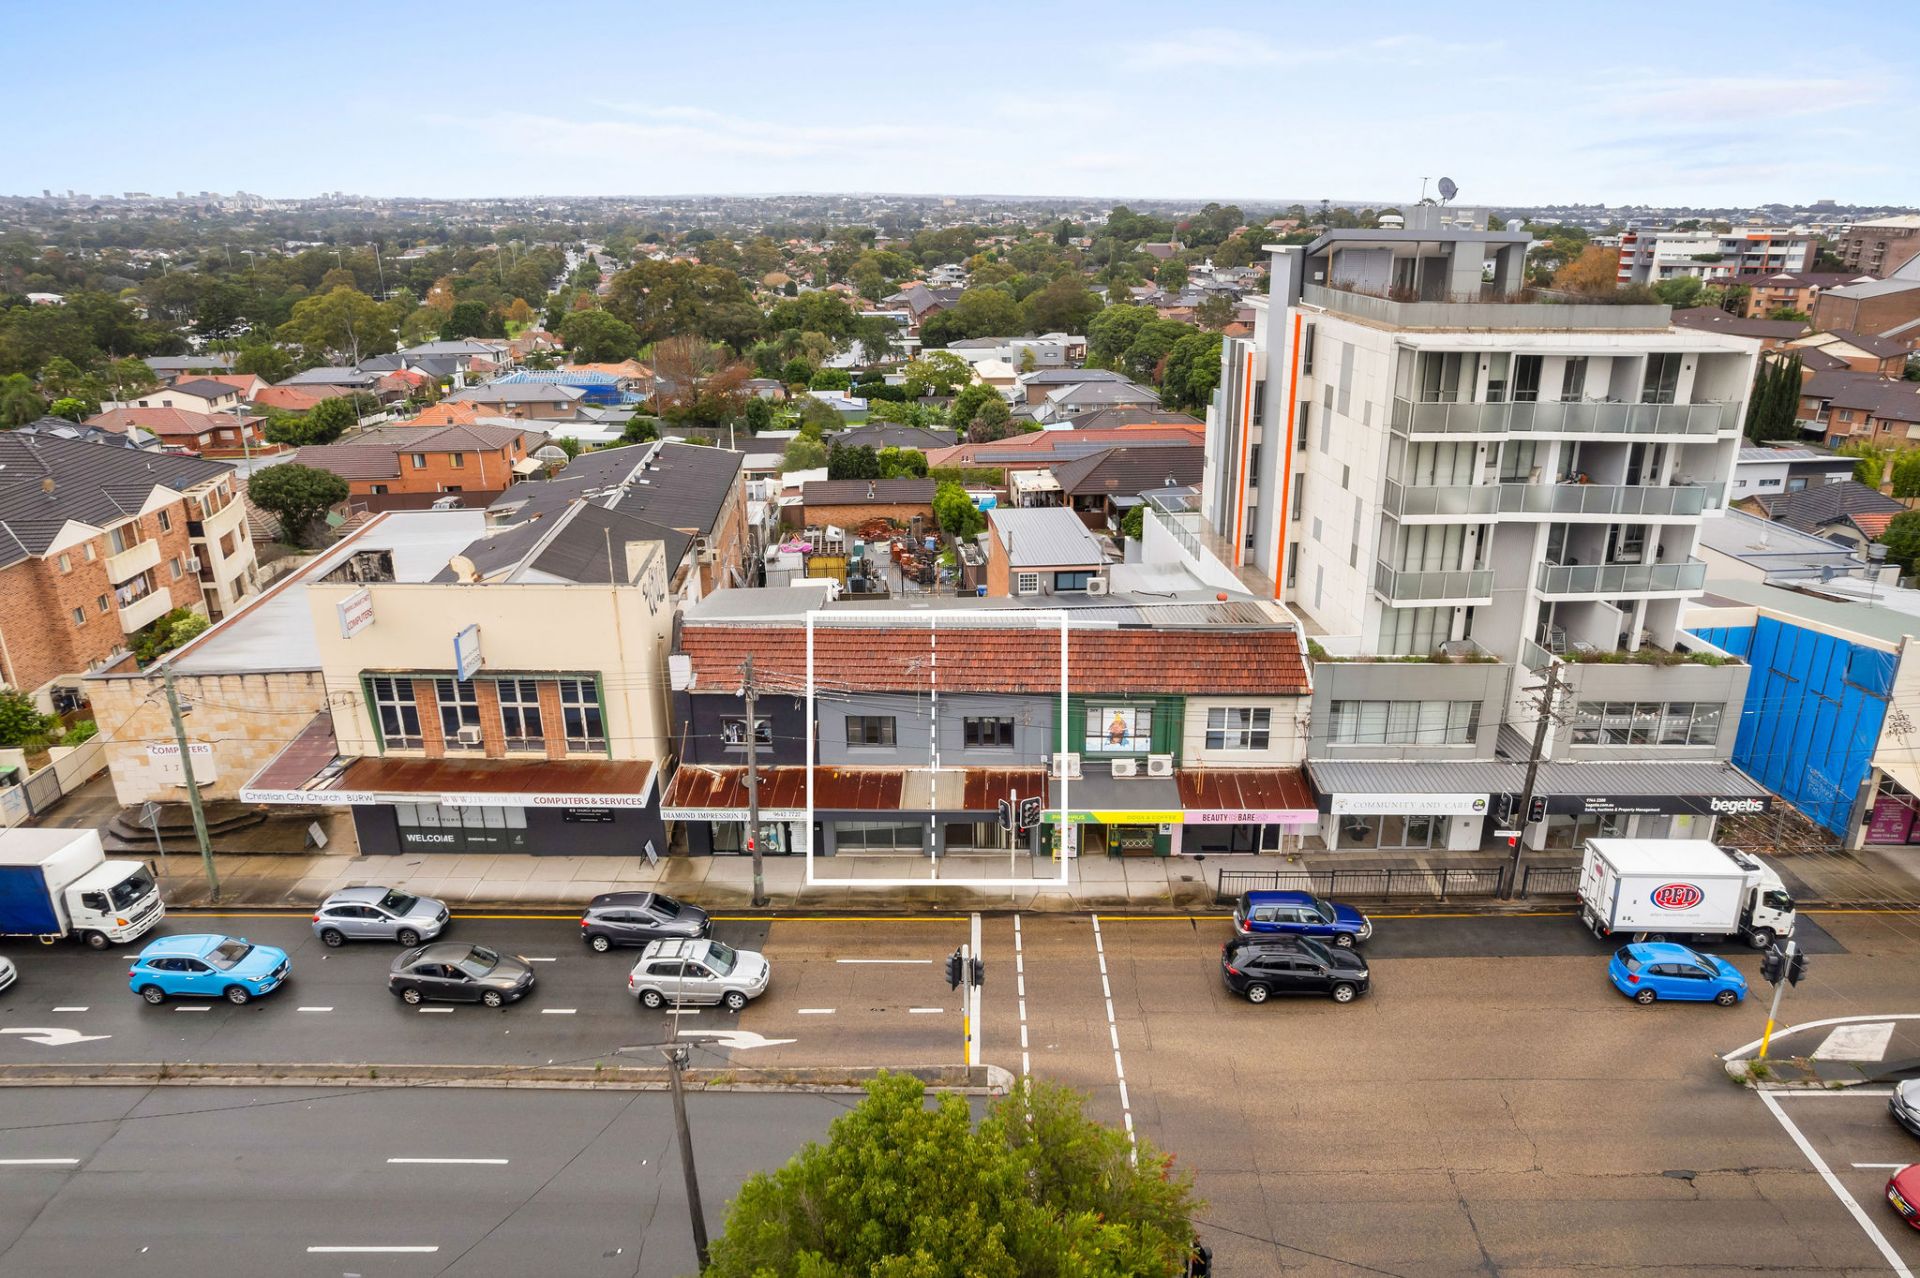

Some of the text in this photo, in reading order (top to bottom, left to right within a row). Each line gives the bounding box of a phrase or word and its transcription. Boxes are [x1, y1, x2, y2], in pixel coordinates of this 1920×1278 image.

[152, 745, 209, 755] COMPTERS
[245, 791, 373, 803] Christian City Church BURW
[533, 796, 643, 806] COMPUTERS & SERVICES
[1353, 801, 1471, 809] COMMUNITY AND CARE
[1710, 797, 1764, 815] begetis
[663, 811, 696, 819] DIAMOND
[697, 811, 739, 820] IMPRESSION
[1202, 813, 1228, 822] BEAUTY
[1237, 813, 1256, 822] BARE
[406, 833, 455, 843] WELCOME
[1660, 887, 1697, 903] PFD
